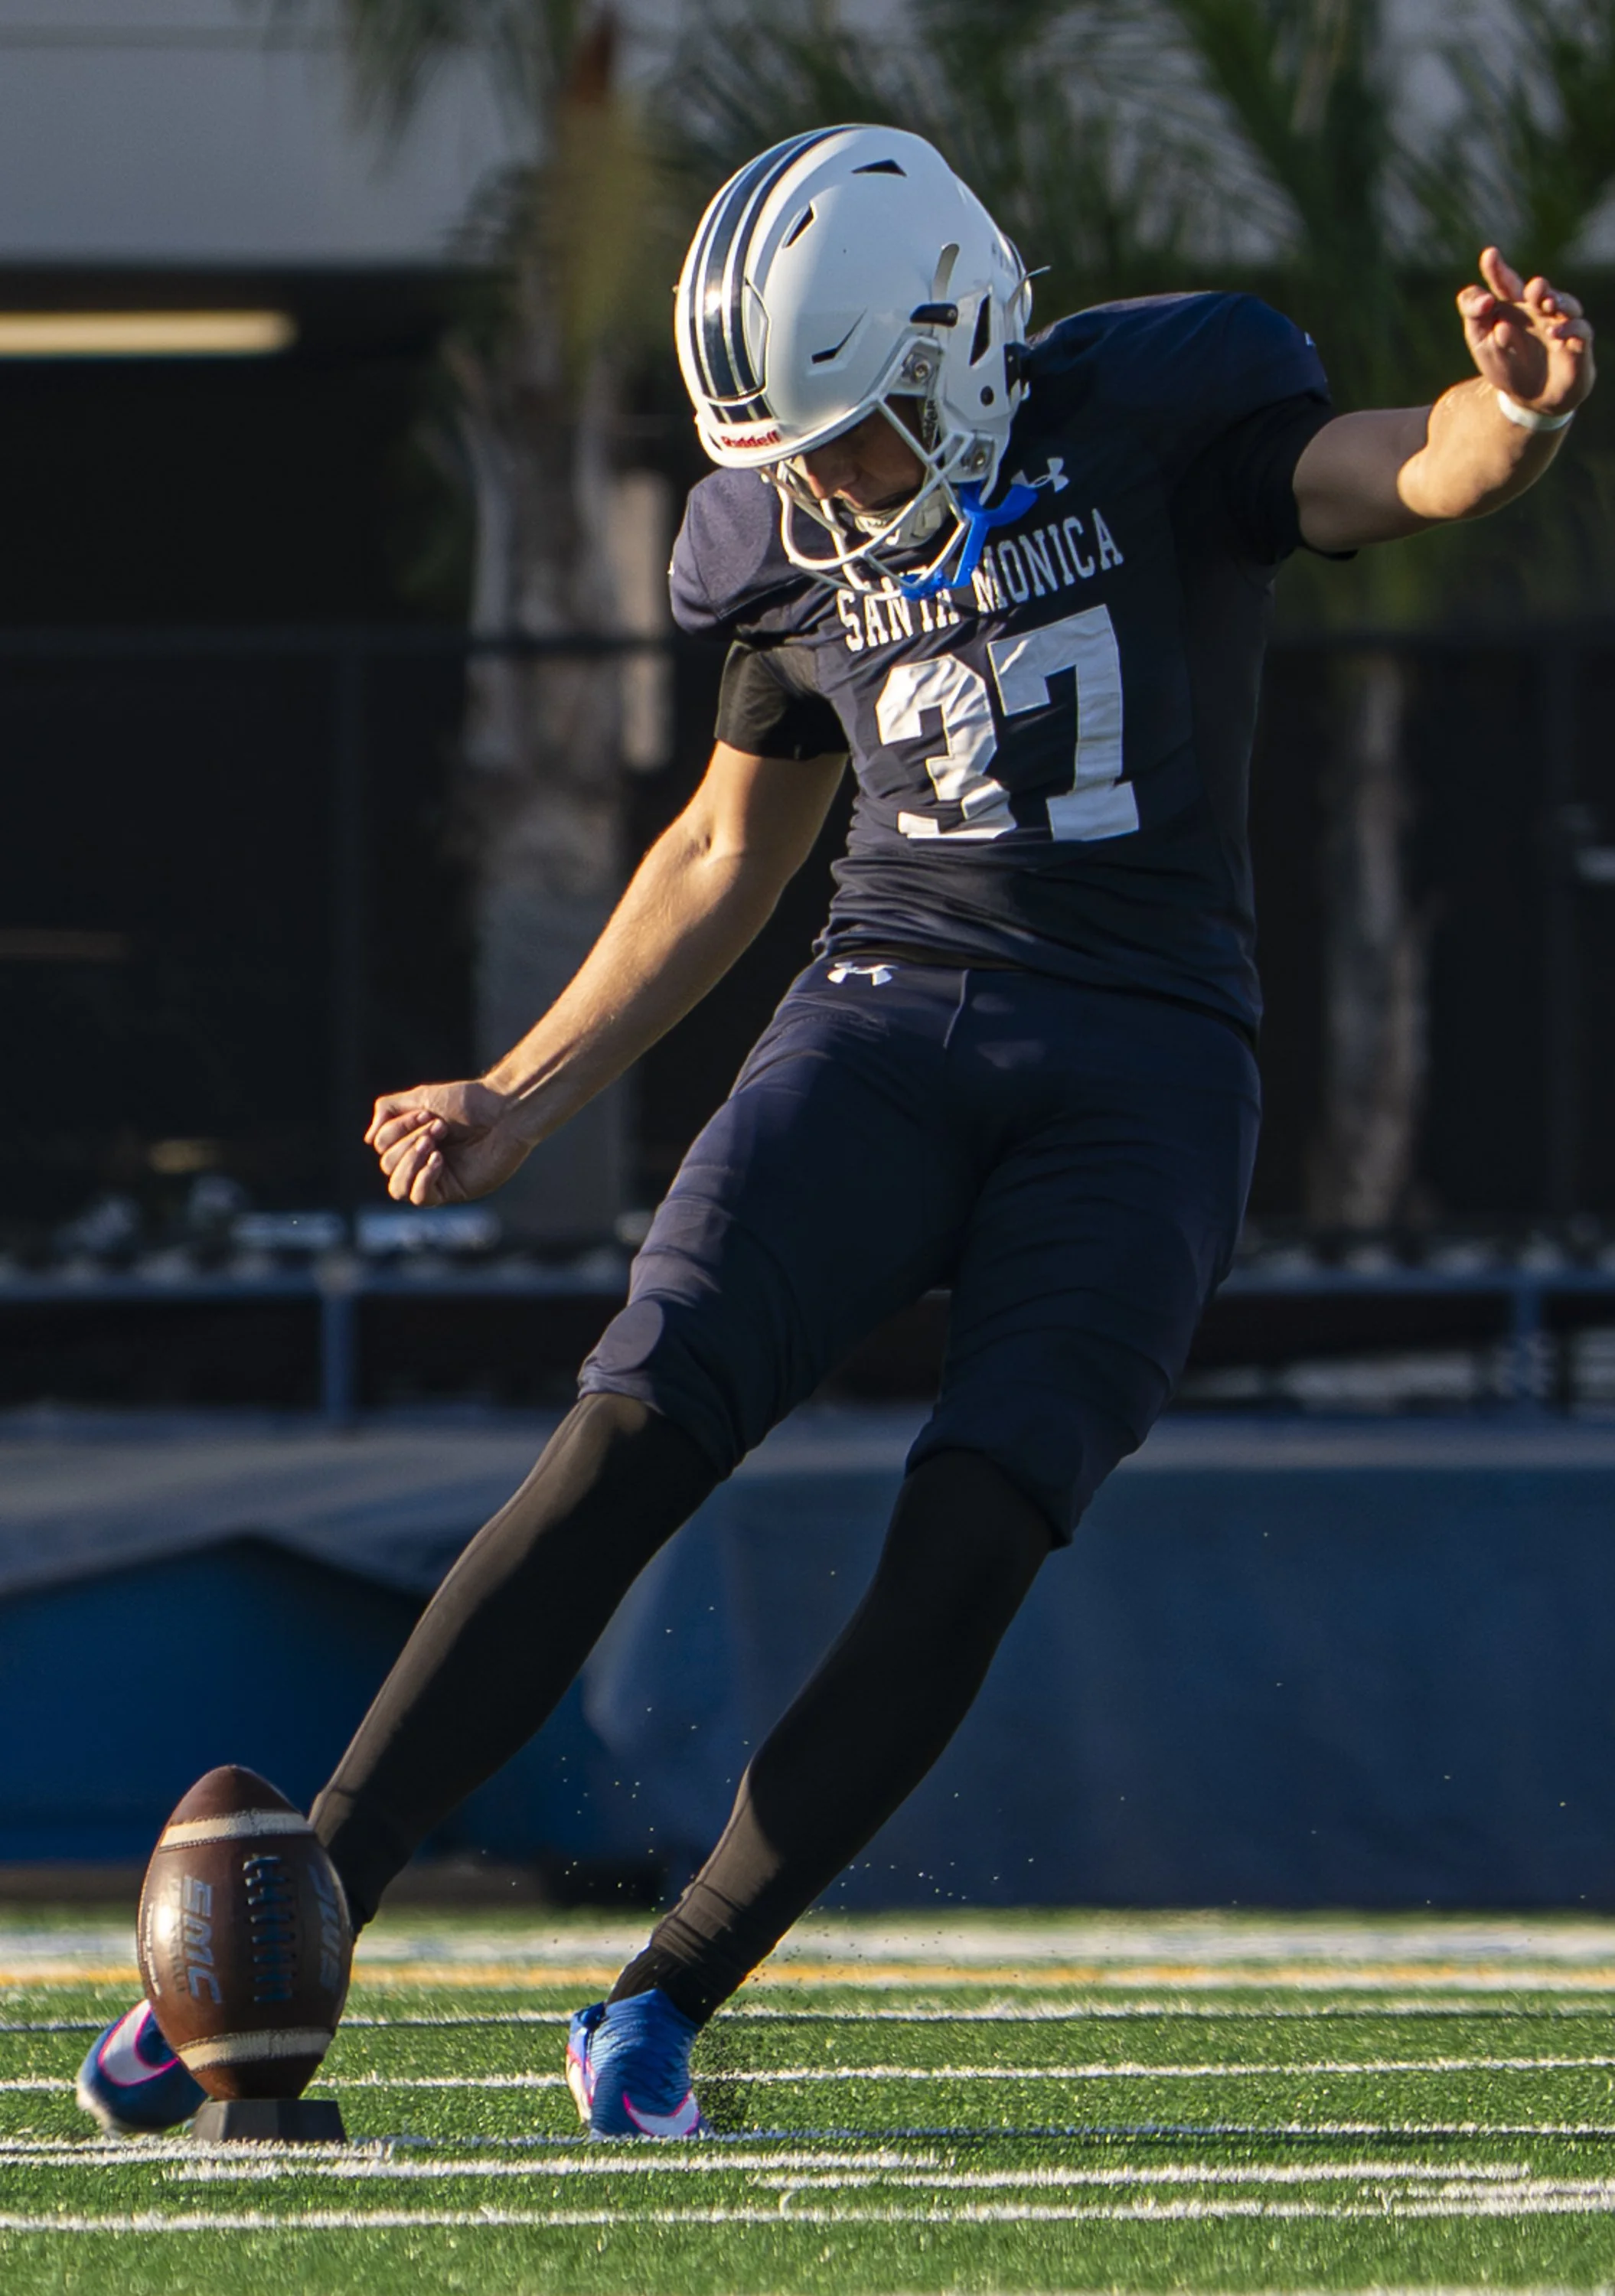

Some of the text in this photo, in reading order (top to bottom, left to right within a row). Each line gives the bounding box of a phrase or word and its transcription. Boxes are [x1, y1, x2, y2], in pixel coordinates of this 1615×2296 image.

[971, 508, 1124, 614] MONICA
[876, 604, 1139, 841] 37
[183, 1875, 222, 2004] SMC
